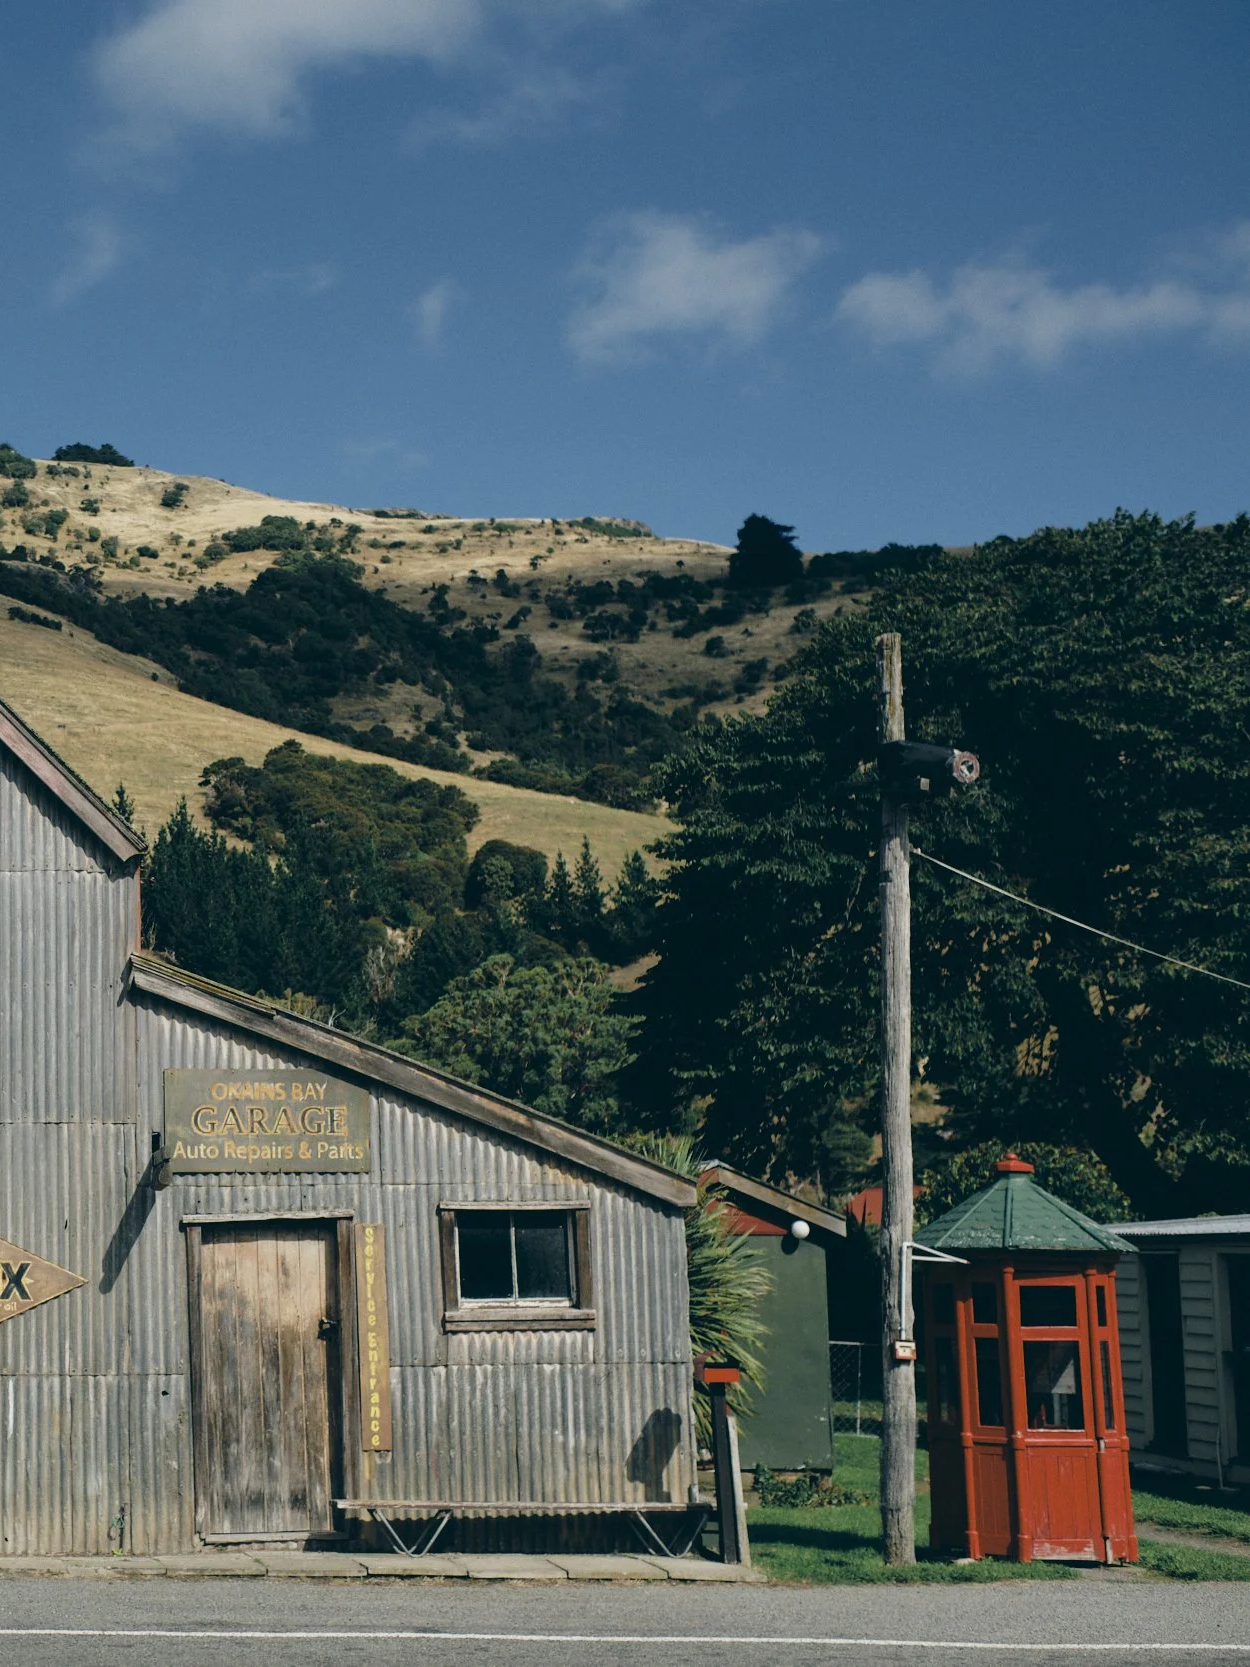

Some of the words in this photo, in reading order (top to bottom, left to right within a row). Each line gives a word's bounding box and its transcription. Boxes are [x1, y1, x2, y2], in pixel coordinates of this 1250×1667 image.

[211, 1082, 286, 1101] OKAINS
[291, 1081, 327, 1101] BAY
[191, 1105, 349, 1137] GARAGE
[173, 1140, 219, 1160] Auto
[224, 1140, 294, 1164] Repairs
[298, 1141, 312, 1160] &
[317, 1141, 364, 1160] Parts
[364, 1227, 378, 1326] Service
[4, 1302, 17, 1312] oil
[367, 1332, 381, 1446] Entrance
